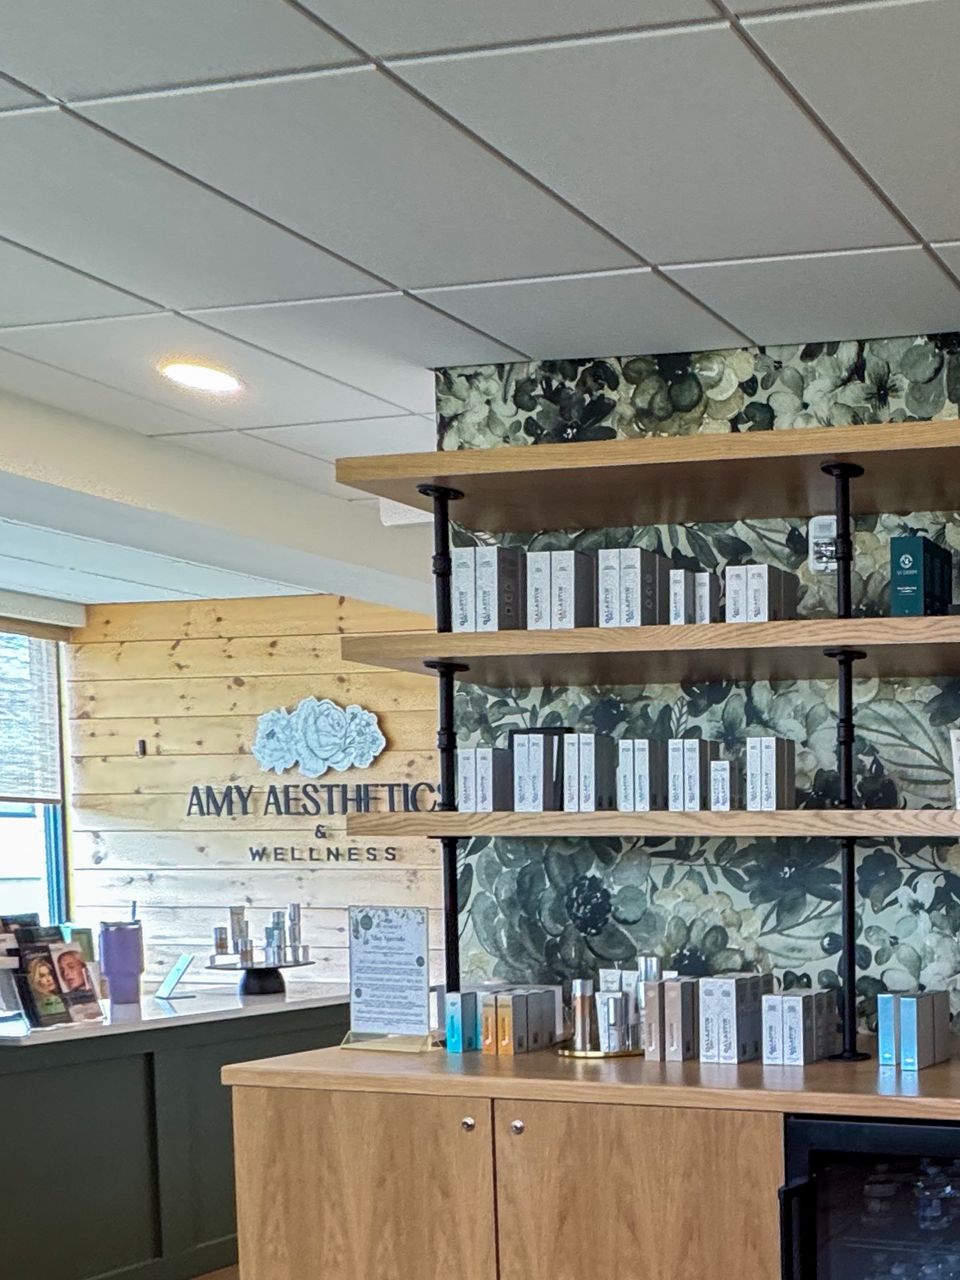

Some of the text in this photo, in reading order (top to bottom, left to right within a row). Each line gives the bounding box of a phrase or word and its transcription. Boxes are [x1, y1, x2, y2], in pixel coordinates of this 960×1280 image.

[187, 784, 254, 817] AMY
[263, 782, 443, 817] AESTHETIC
[314, 824, 328, 838] &
[249, 846, 398, 862] WELLNESS
